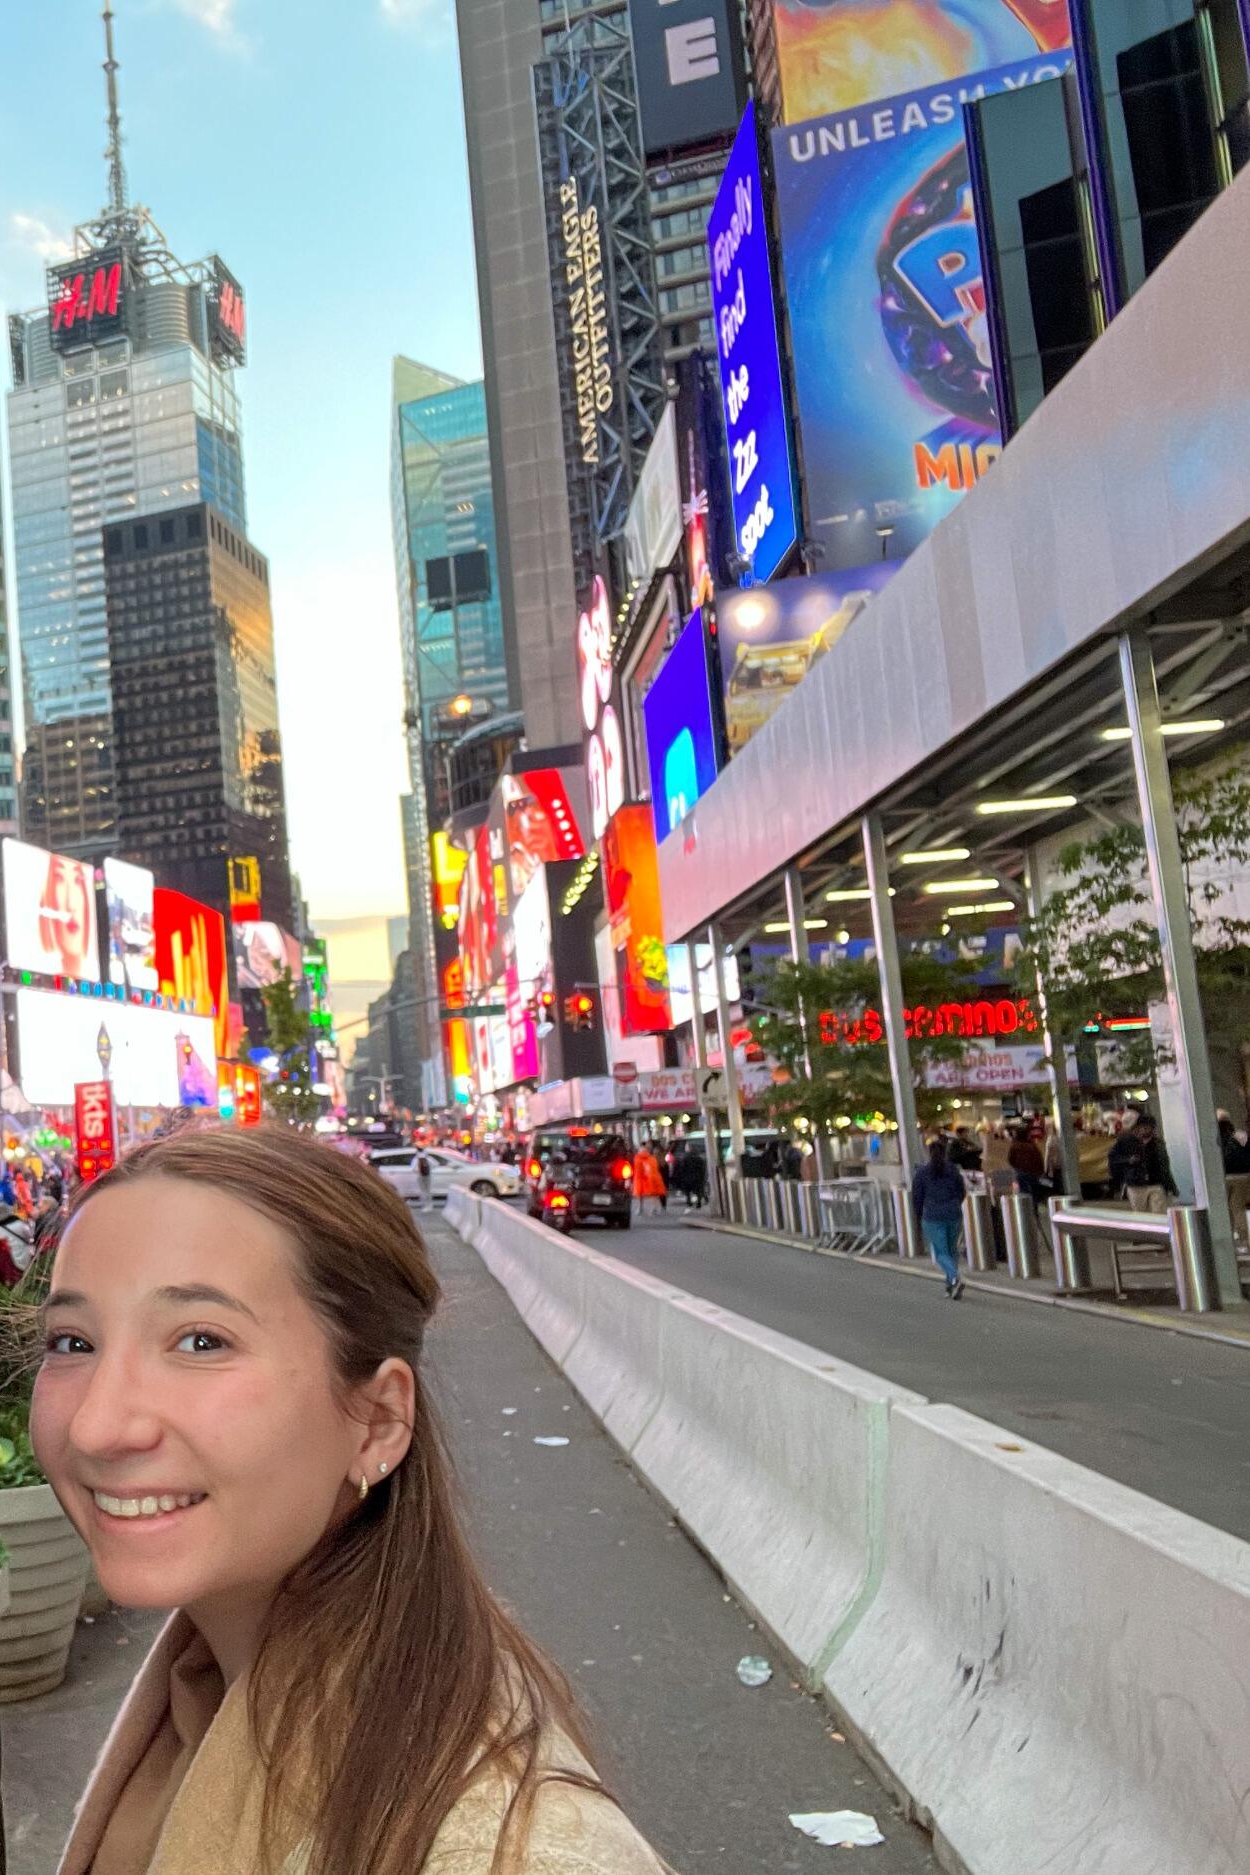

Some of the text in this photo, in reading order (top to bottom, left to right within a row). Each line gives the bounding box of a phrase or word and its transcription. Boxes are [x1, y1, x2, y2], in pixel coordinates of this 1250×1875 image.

[789, 84, 985, 162] UNLEASH
[714, 174, 752, 292] Finally
[52, 263, 122, 331] H&M
[219, 281, 246, 347] HM
[560, 175, 599, 463] AMERICAN EAGLE
[580, 205, 614, 413] OUTFITTERS
[720, 268, 747, 359] find
[727, 363, 750, 426] the
[82, 1083, 108, 1140] tkts
